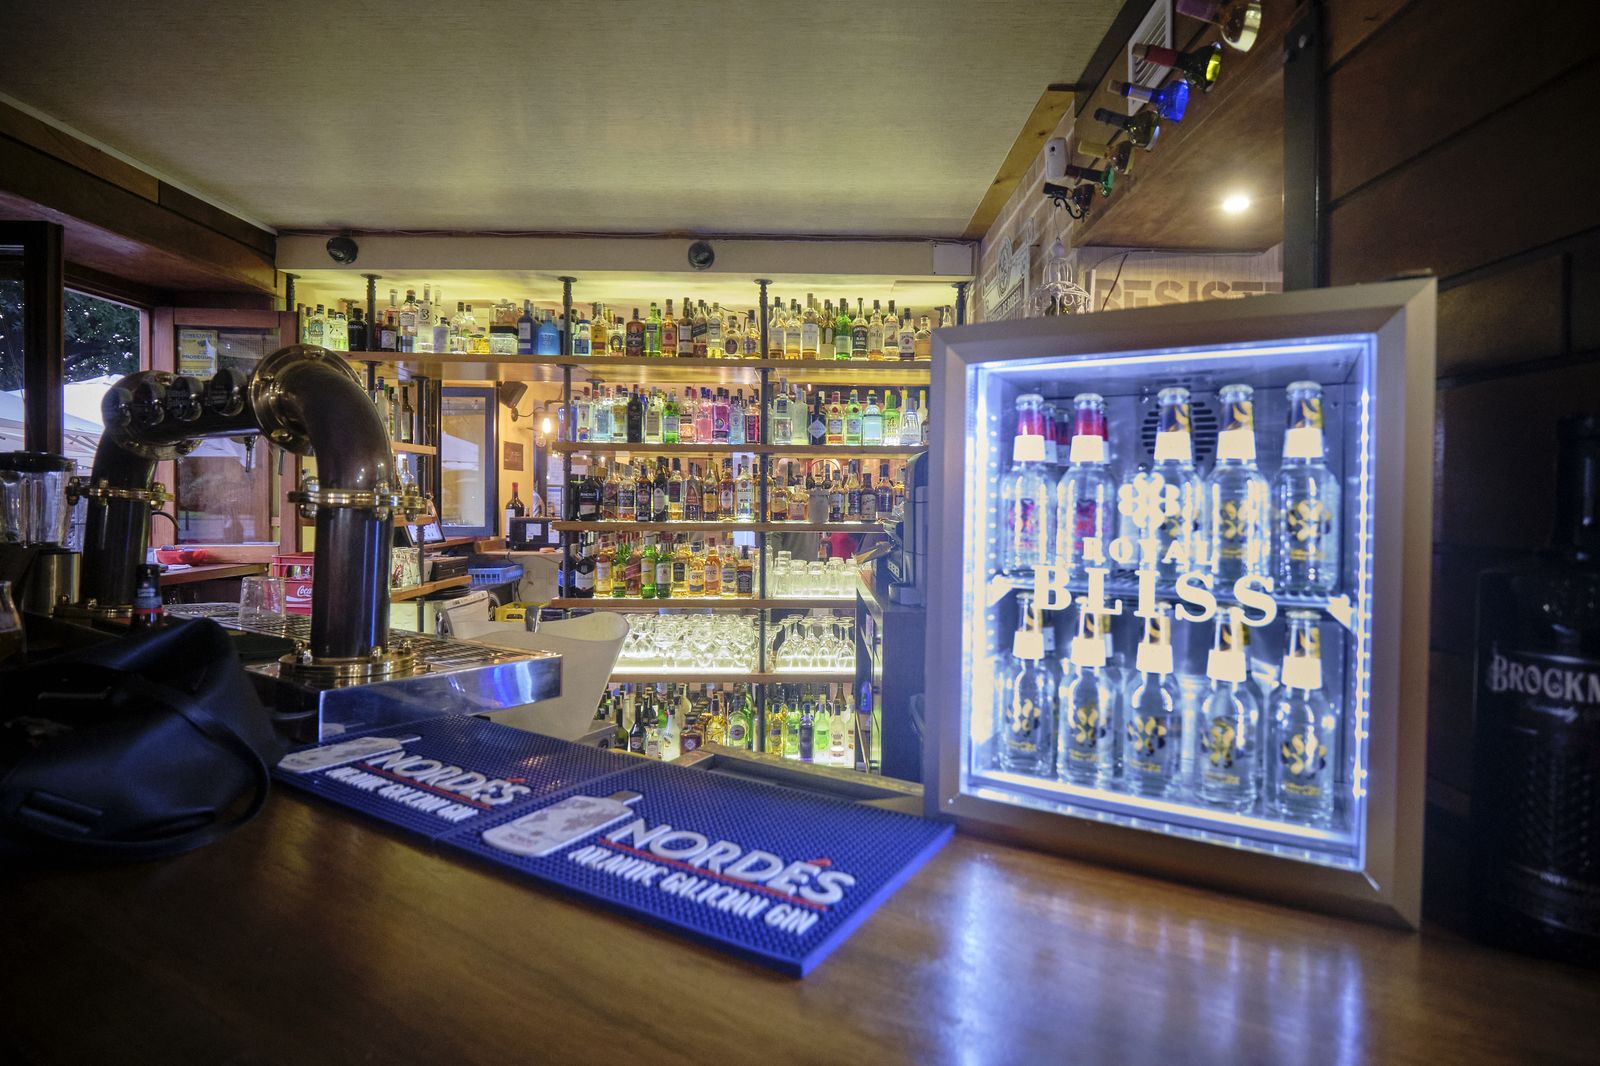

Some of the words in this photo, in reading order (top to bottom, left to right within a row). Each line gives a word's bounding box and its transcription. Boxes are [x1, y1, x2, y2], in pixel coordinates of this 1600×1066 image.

[1095, 278, 1283, 312] RESIS
[1082, 535, 1217, 566] ROYAL
[1032, 563, 1278, 627] BLISS
[365, 750, 531, 806] NORDÉS
[605, 817, 855, 905] NORDÉS
[660, 871, 770, 920] GALICIAN
[765, 903, 820, 935] GIN
